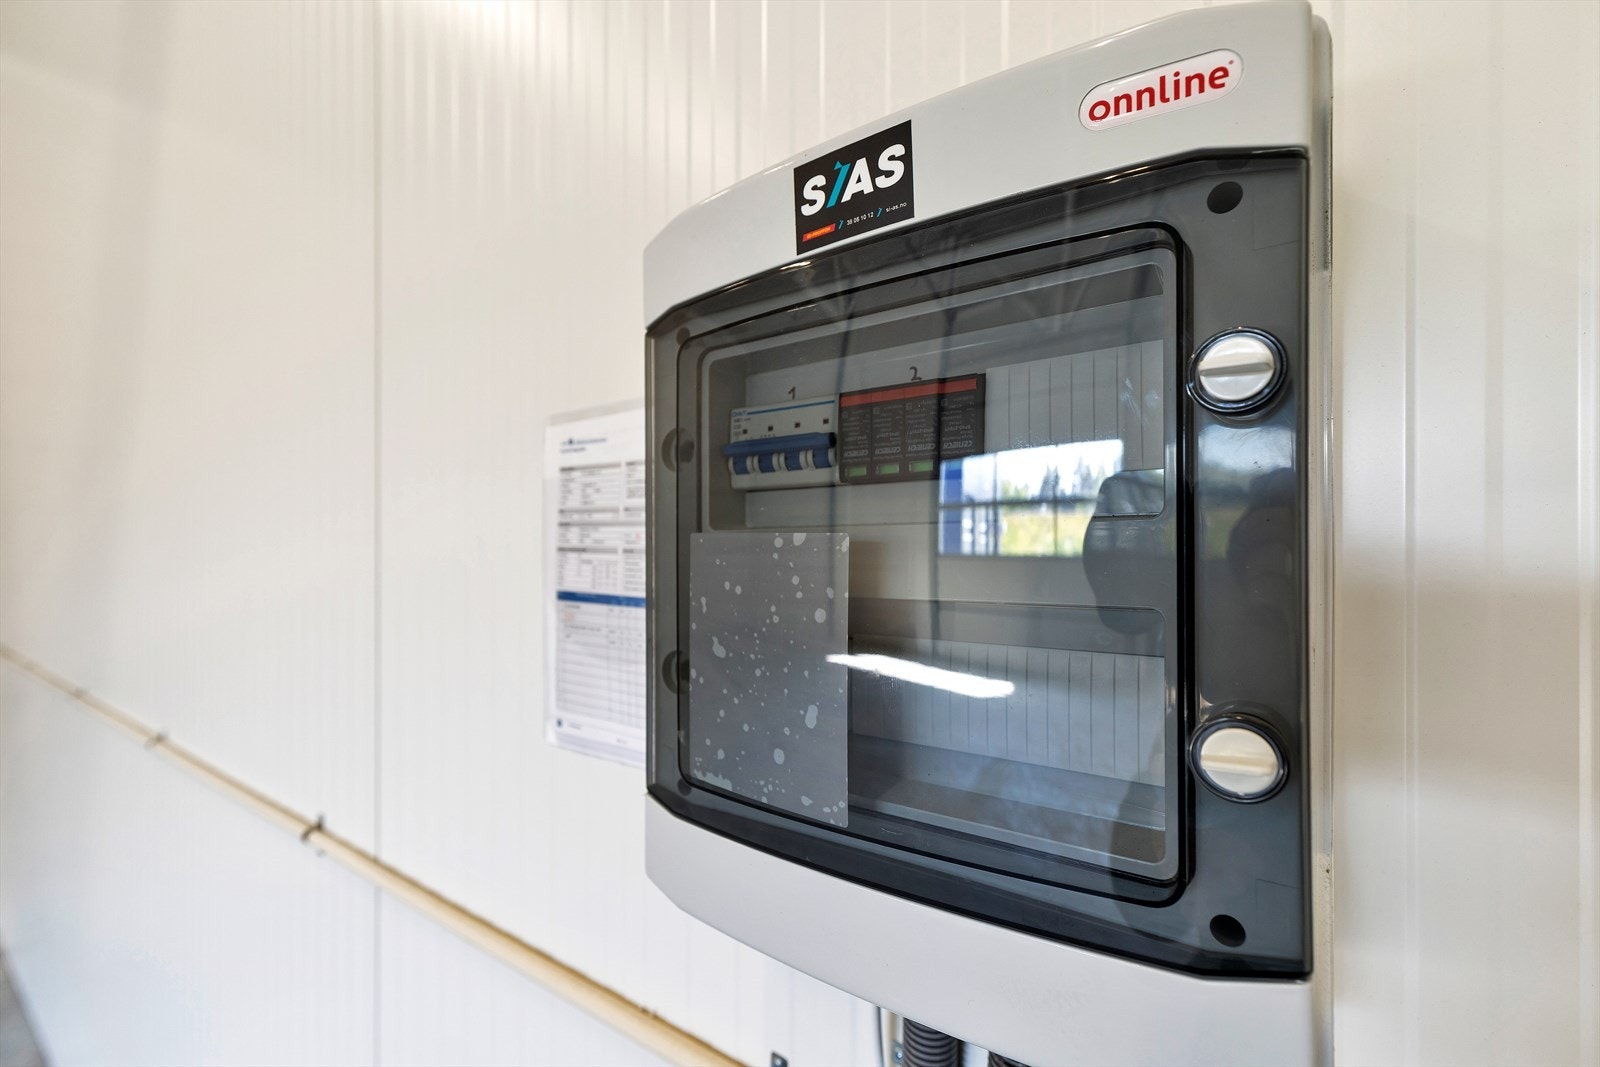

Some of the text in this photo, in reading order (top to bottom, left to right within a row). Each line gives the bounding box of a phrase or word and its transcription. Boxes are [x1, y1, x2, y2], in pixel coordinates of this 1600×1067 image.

[1088, 65, 1230, 122] onnline
[909, 366, 922, 381] 2
[788, 386, 797, 400] 1
